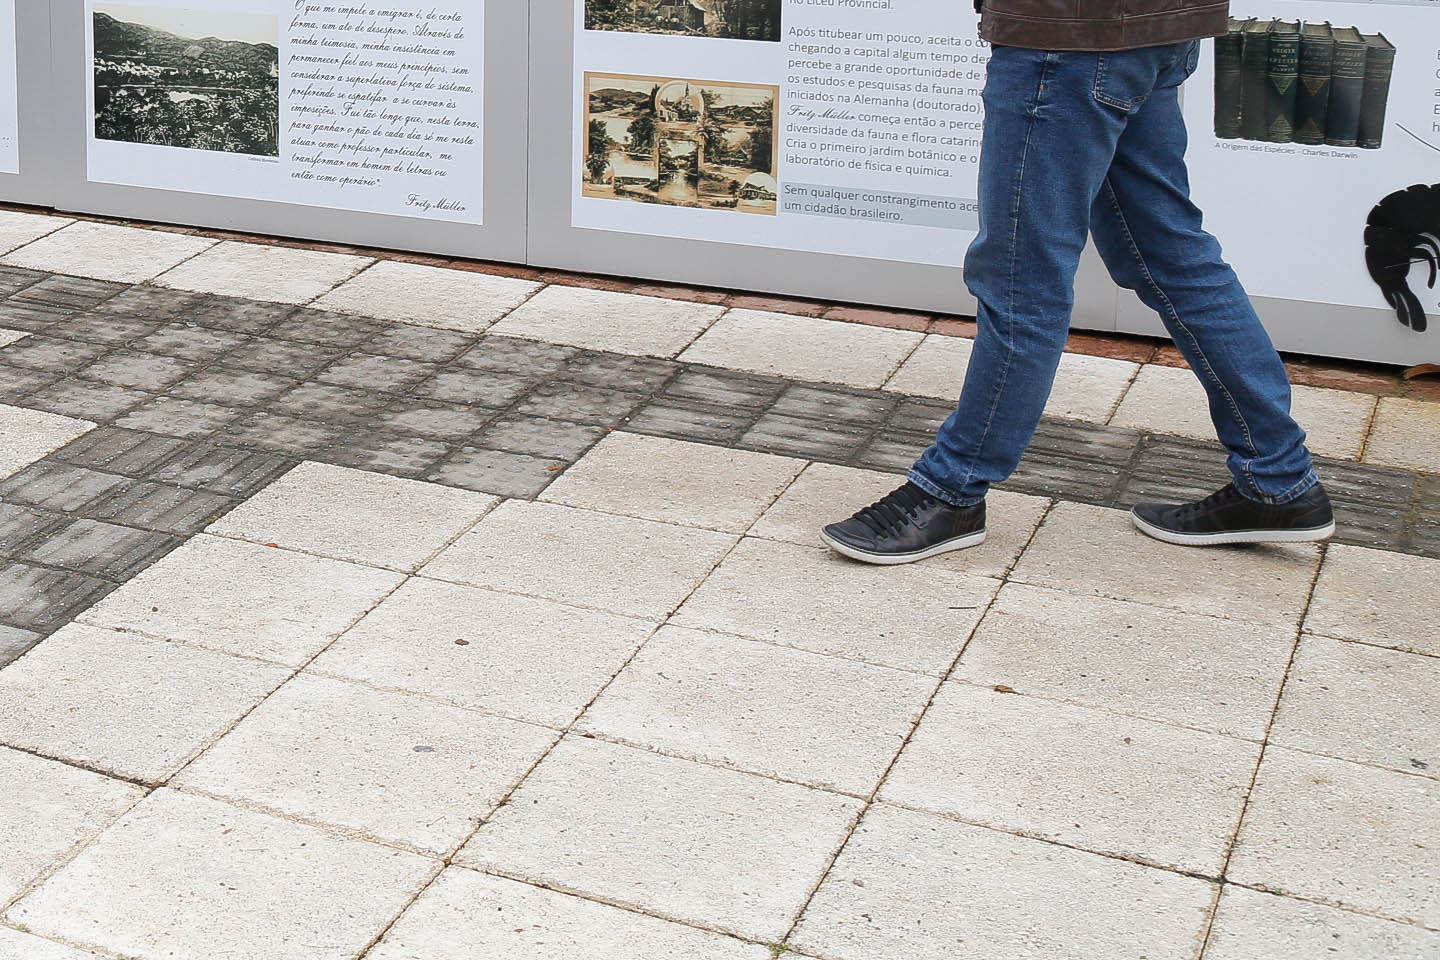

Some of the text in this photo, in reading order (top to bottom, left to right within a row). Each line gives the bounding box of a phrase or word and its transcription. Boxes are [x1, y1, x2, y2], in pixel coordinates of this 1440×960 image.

[784, 183, 957, 211] Sem qualquer constrangimento
[784, 201, 903, 222] um cidadão brasileiro.
